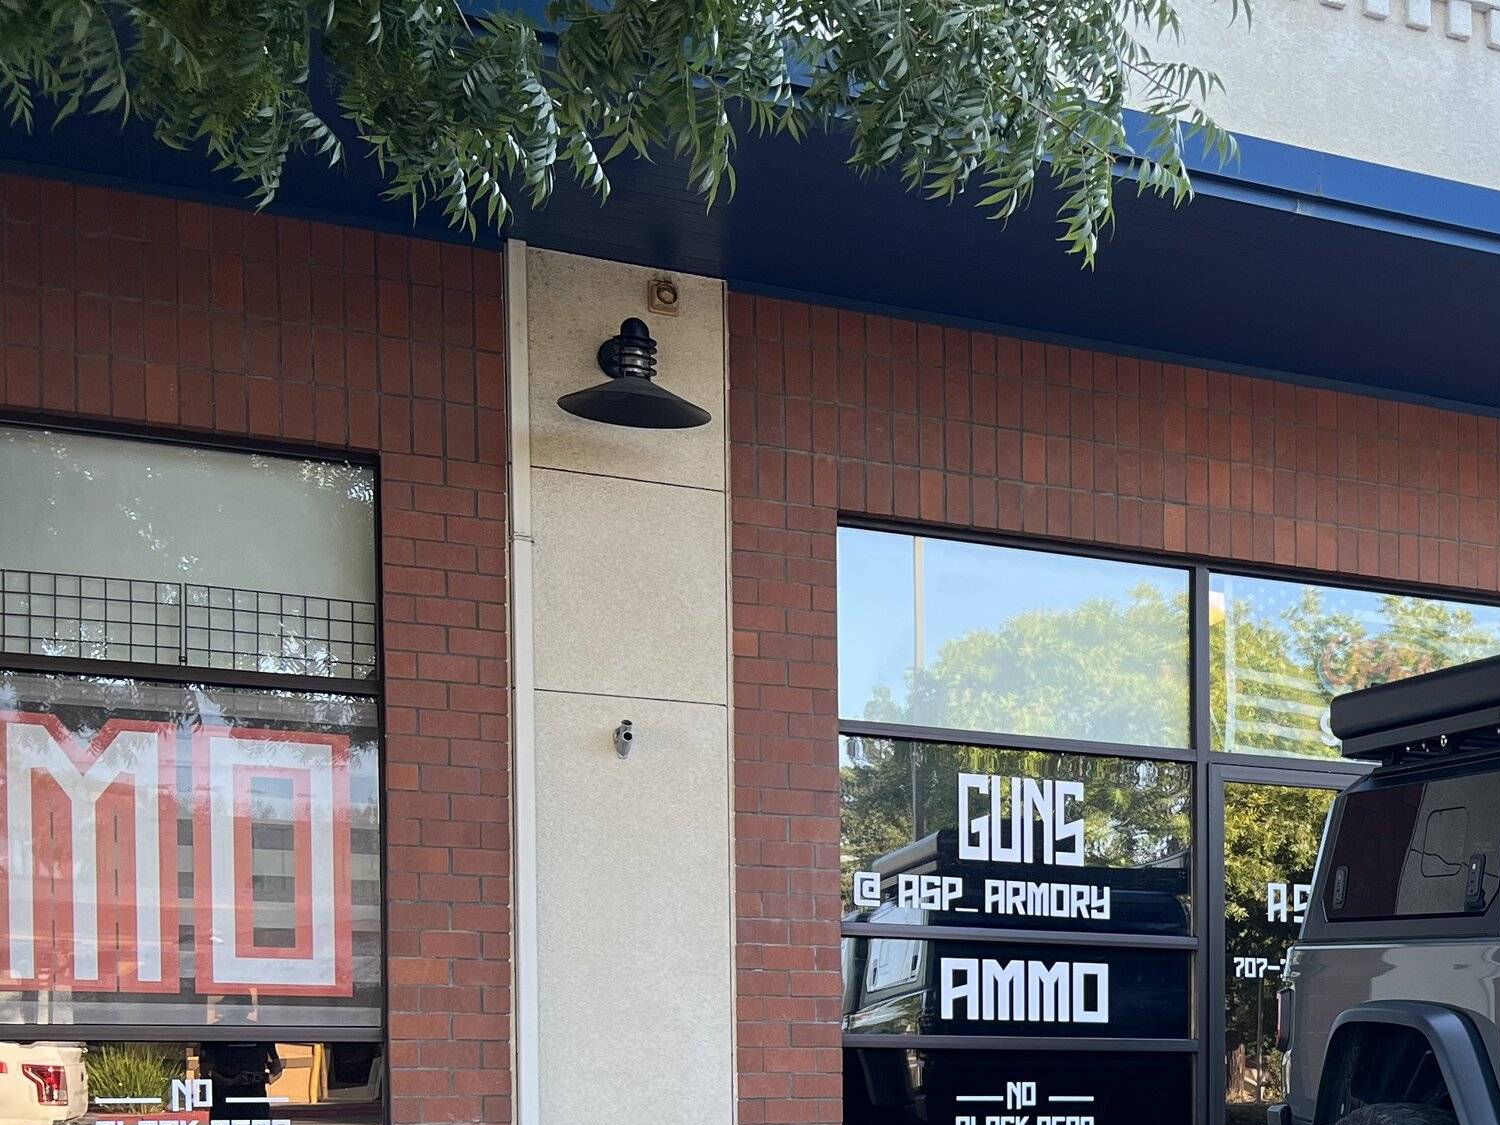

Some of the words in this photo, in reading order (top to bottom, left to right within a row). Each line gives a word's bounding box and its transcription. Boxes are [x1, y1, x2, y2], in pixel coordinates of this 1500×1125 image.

[957, 772, 1085, 867] GUNS
[853, 871, 881, 907] @
[940, 956, 1109, 1024] AMMO
[171, 1078, 213, 1112] NO
[1006, 1080, 1037, 1109] NO
